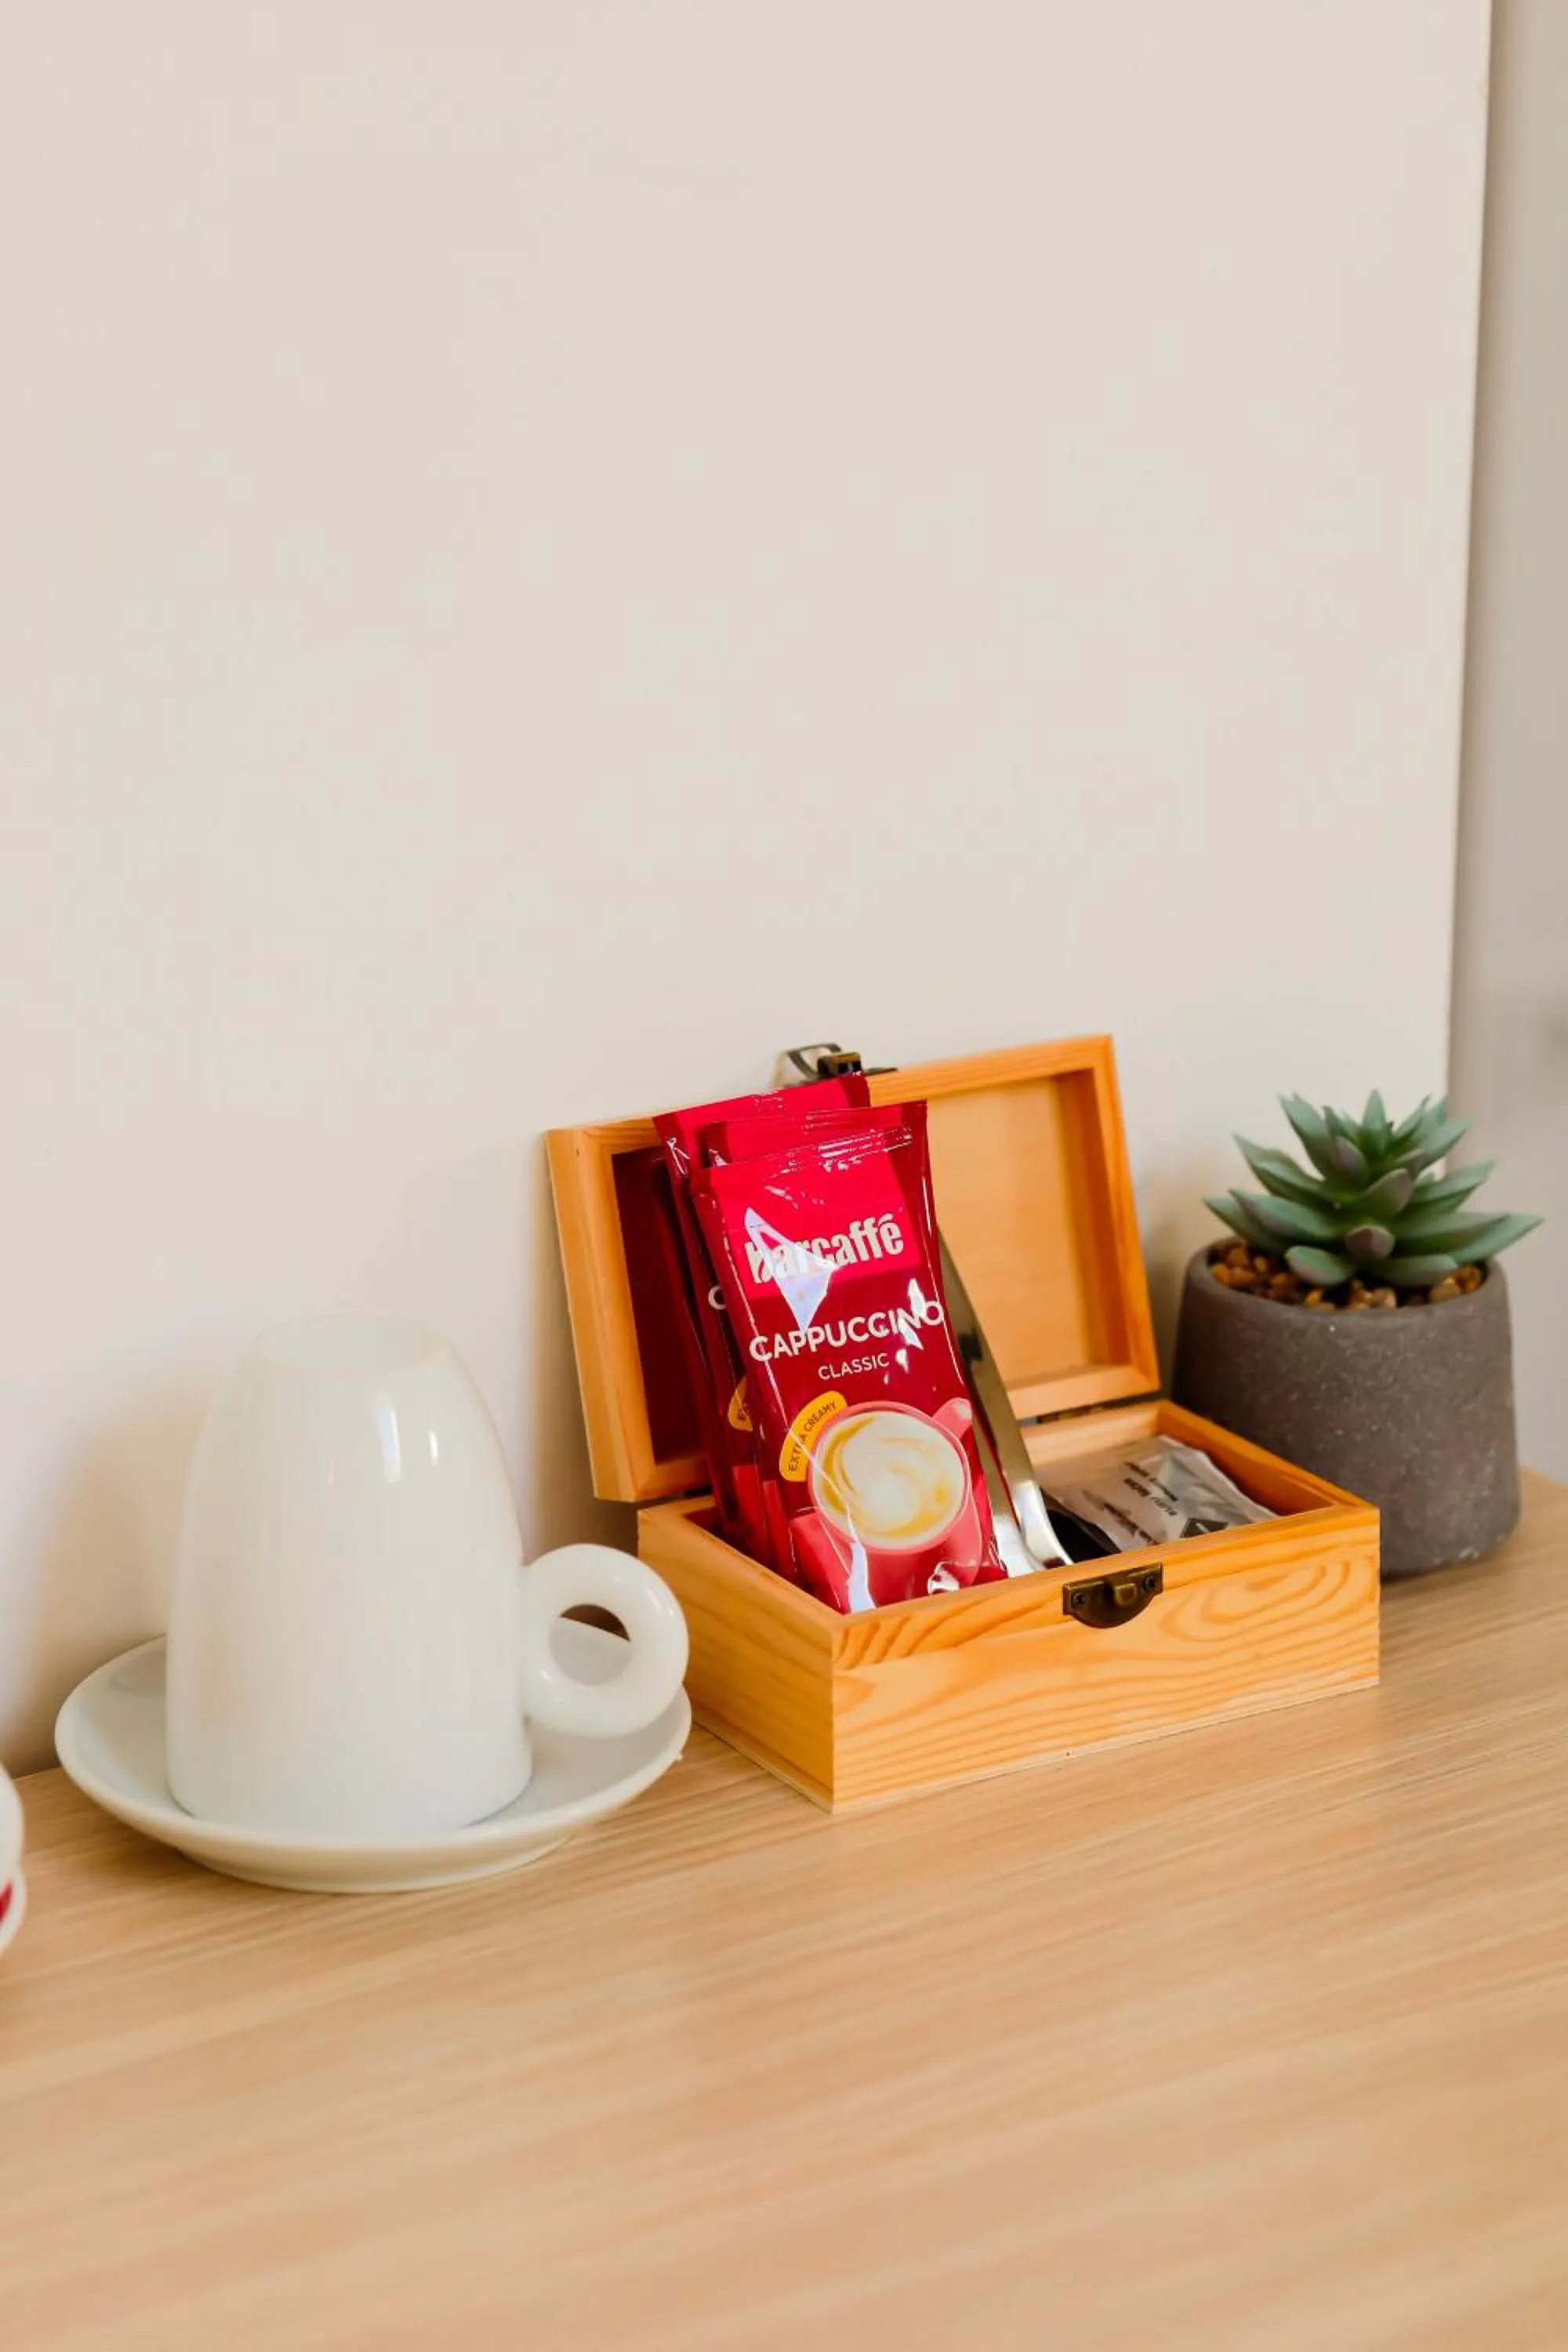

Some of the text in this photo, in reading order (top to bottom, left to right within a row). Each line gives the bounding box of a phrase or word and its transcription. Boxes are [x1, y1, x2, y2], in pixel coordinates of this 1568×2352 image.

[749, 1301, 943, 1362] CAPPUCCINO
[818, 1352, 890, 1381] CLASSIC
[804, 1400, 837, 1432] CREAMY
